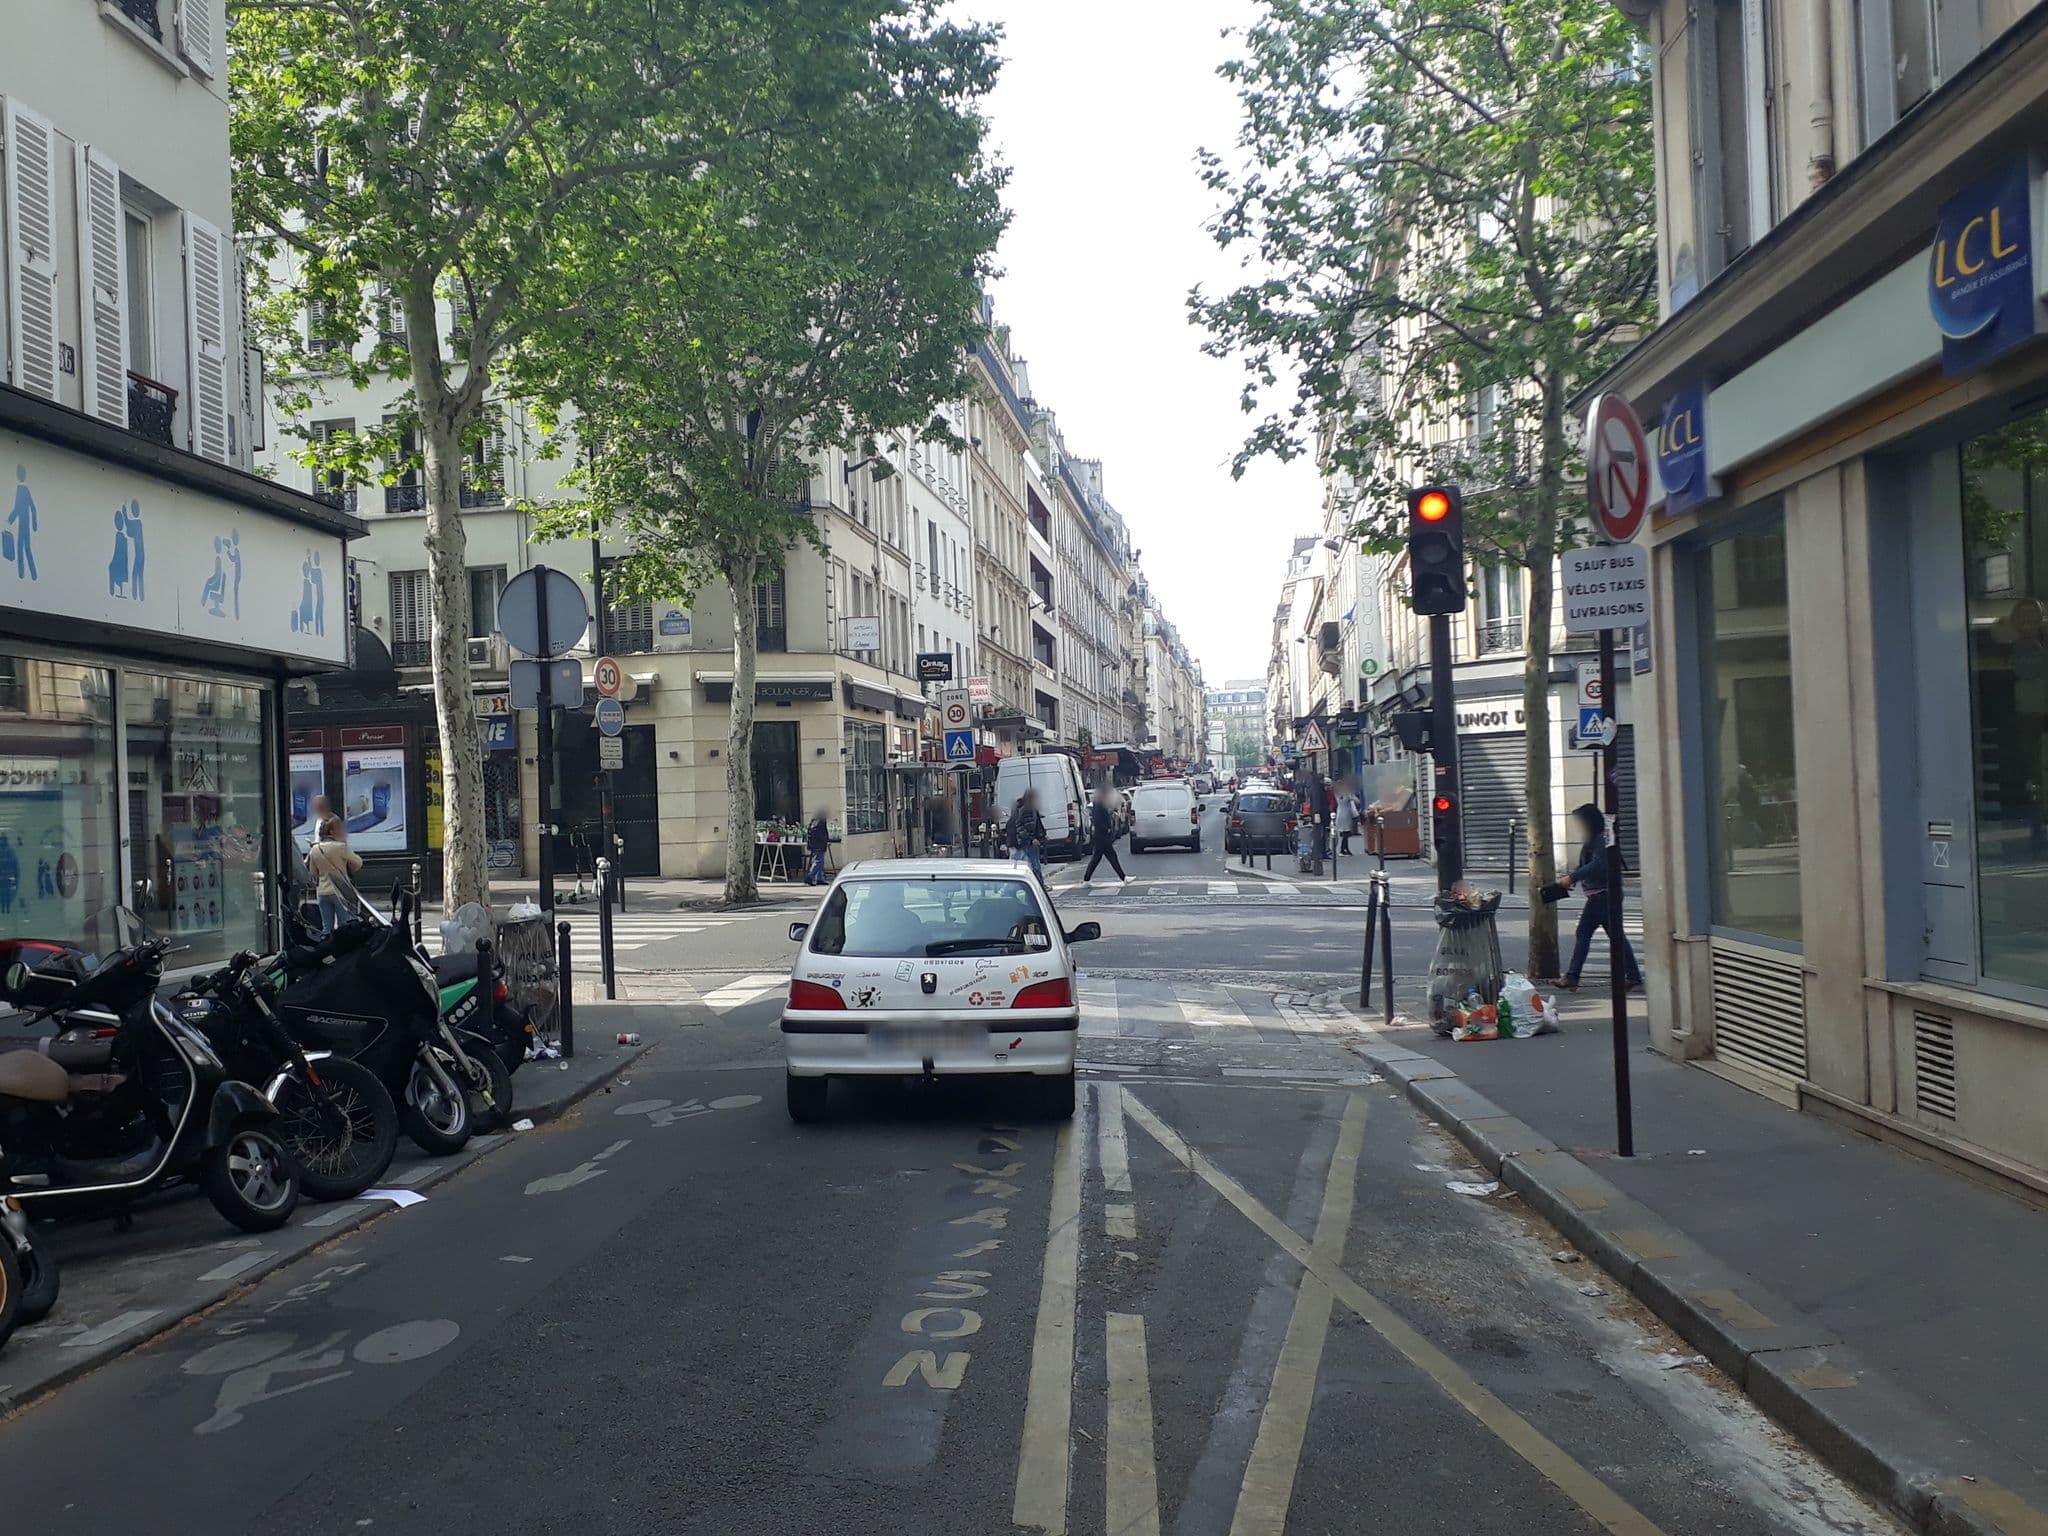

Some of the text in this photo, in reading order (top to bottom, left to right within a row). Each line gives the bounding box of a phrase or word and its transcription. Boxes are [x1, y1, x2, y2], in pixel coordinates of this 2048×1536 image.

[1936, 207, 2018, 288] LCL
[1659, 408, 1701, 457] LCL
[1574, 556, 1635, 573] SAUF BUS
[1567, 578, 1646, 597] VÉLOS TAXIS
[1569, 601, 1645, 619] LIVRAISONS
[600, 668, 617, 685] 30
[761, 687, 810, 696] BOULANGER
[946, 693, 964, 701] ZONE
[1589, 685, 1602, 694] 30
[951, 709, 962, 718] 30
[1456, 711, 1508, 728] LINGOT
[806, 971, 847, 980] PEUGEOT
[448, 995, 478, 1024] COUP
